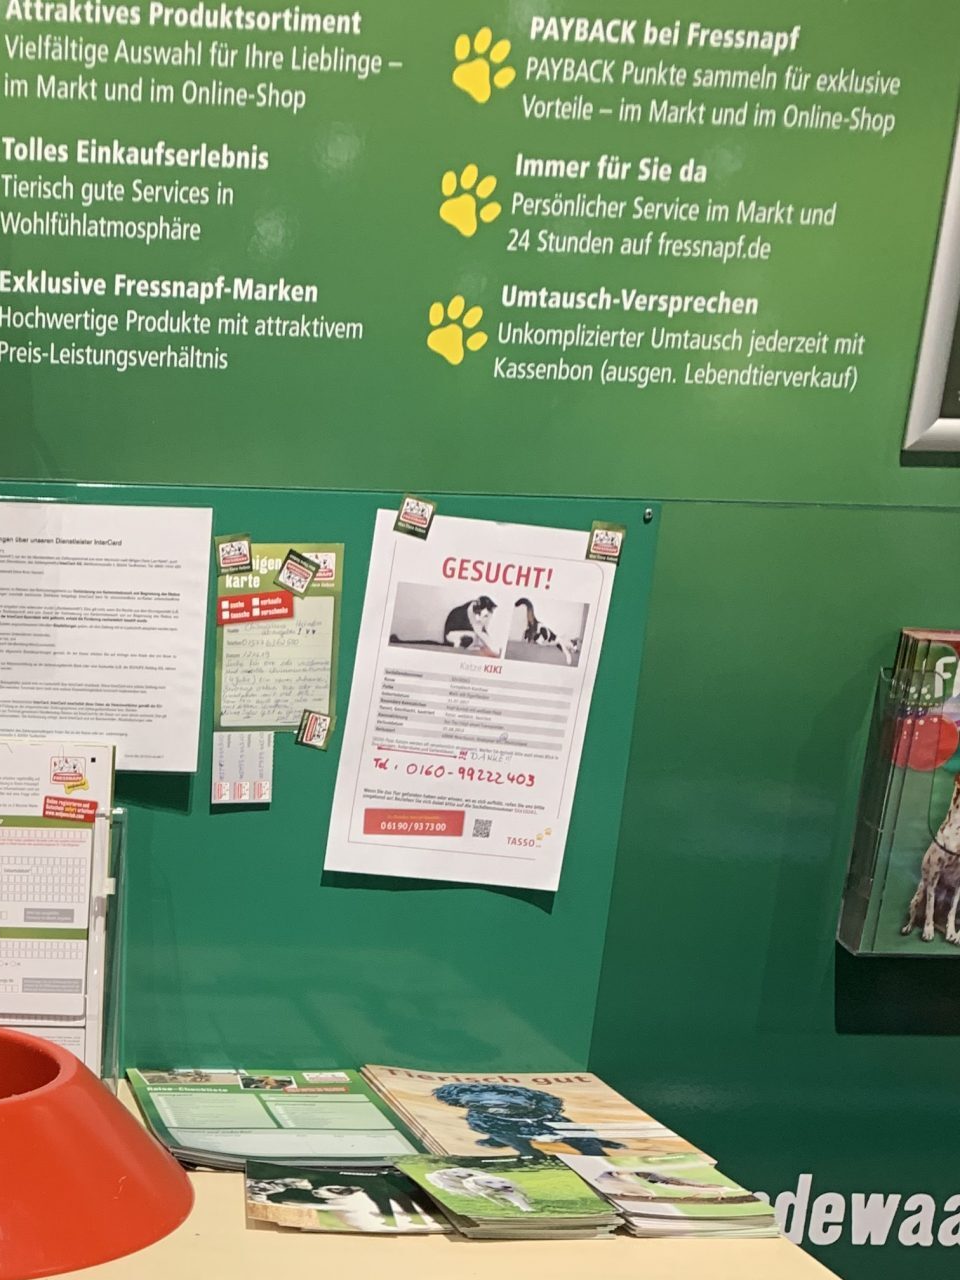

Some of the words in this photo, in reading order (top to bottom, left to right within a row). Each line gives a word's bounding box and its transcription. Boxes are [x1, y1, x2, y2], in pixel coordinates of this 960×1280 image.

[5, 0, 140, 25] Attraktives
[149, 2, 362, 36] Produktsortiment
[529, 16, 637, 45] PAYBACK
[643, 20, 680, 47] bei
[686, 22, 802, 57] Fressnapf
[4, 34, 110, 68] Vielfältige
[114, 41, 202, 67] Auswahl
[210, 42, 240, 69] für
[246, 45, 284, 71] Ihre
[291, 46, 383, 79] Lieblinge
[4, 73, 28, 98] im
[36, 75, 98, 101] Markt
[104, 78, 142, 104] und
[150, 79, 174, 104] im
[182, 80, 307, 114] Online-Shop
[525, 57, 615, 85] PAYBACK
[621, 60, 688, 87] Punkte
[693, 65, 778, 92] sammeln
[784, 66, 811, 93] für
[816, 69, 902, 95] exklusive
[522, 94, 594, 121] Vorteile
[618, 98, 642, 123] im
[648, 100, 707, 126] Markt
[711, 102, 748, 128] und
[753, 103, 777, 129] im
[782, 104, 897, 138] Online-Shop
[1, 137, 69, 164] Tolles
[76, 138, 270, 171] Einkaufserlebnis
[515, 154, 590, 180] Immer
[597, 155, 632, 182] für
[637, 156, 673, 183] Sie
[678, 159, 708, 184] da
[1, 173, 75, 202] Tierisch
[80, 178, 126, 210] gute
[131, 179, 210, 206] Services
[217, 181, 235, 207] in
[0, 210, 202, 245] Wohlfühlatmosphäre
[511, 192, 626, 221] Persönlicher
[632, 195, 700, 223] Service
[705, 198, 730, 223] im
[736, 200, 795, 226] Markt
[799, 202, 838, 228] und
[506, 229, 531, 254] 24
[537, 229, 615, 256] Stunden
[620, 231, 654, 257] auf
[657, 232, 772, 264] fressnapf.de
[0, 269, 108, 298] Exklusive
[114, 273, 319, 305] Fressnapf-Marken
[501, 284, 760, 319] Umtausch-Versprechen
[125, 309, 212, 336] Produkte
[217, 312, 249, 337] mit
[254, 314, 365, 341] attraktivem
[498, 321, 645, 352] Unkomplizierter
[650, 327, 743, 353] Umtausch
[746, 329, 829, 357] jederzeit
[833, 332, 867, 357] mit
[494, 357, 594, 384] Kassenbon
[600, 360, 678, 391] (ausgen.
[684, 363, 859, 394] Lebendtierverkauf)
[225, 573, 261, 589] karte
[442, 556, 554, 590] GESUCHT!
[484, 663, 503, 675] KIKI
[380, 821, 447, 832] 06190/937300
[506, 836, 536, 848] TASSO
[386, 1067, 521, 1084] Tierisch
[532, 1074, 592, 1087] gut
